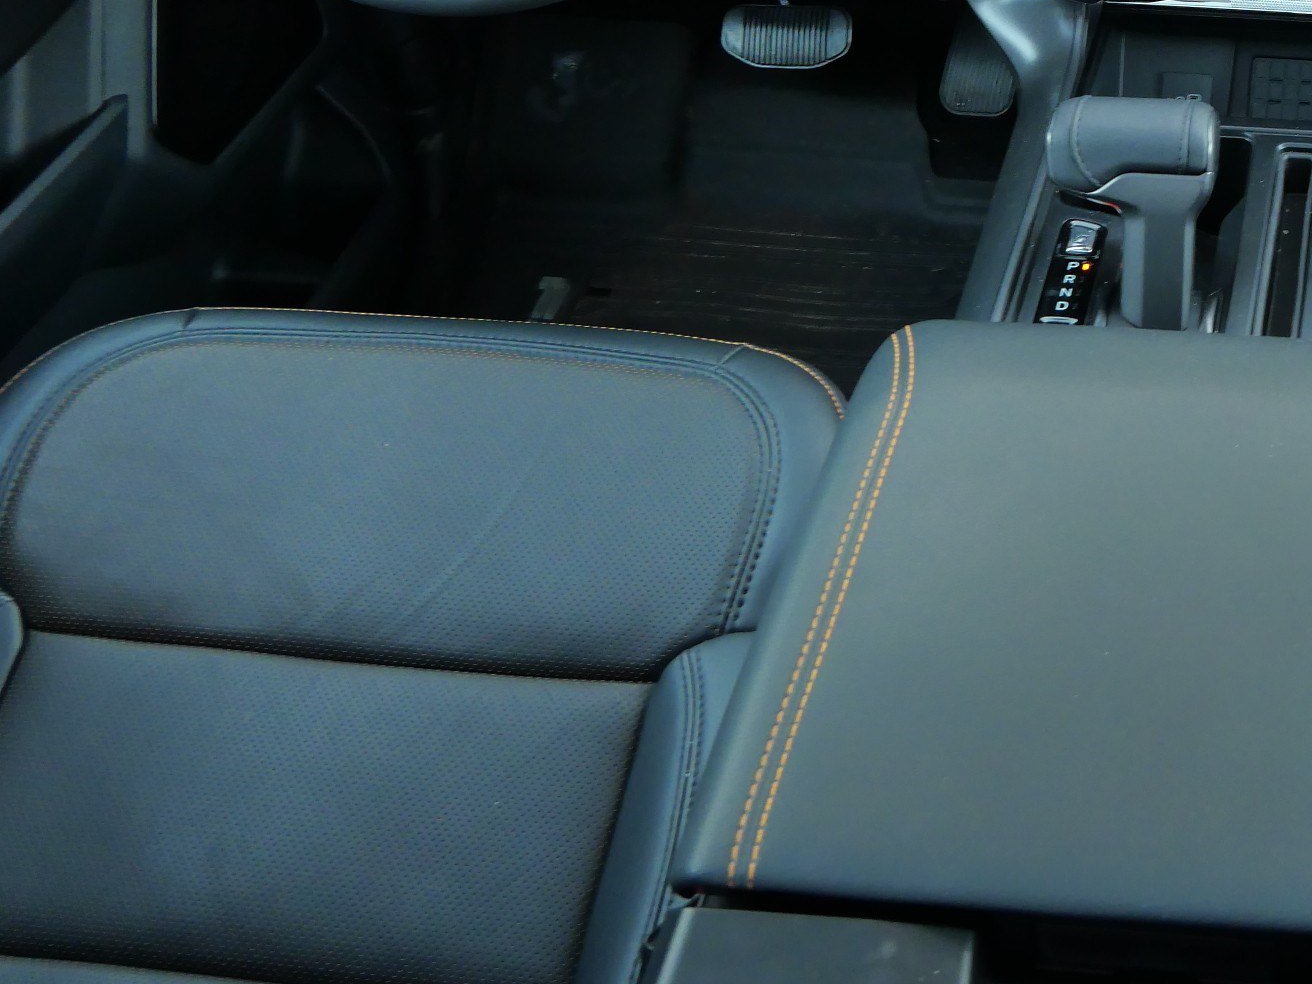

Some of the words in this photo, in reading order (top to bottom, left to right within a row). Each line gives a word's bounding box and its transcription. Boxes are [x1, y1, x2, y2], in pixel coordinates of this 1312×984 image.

[1066, 262, 1080, 271] P
[1062, 275, 1077, 284] R
[1059, 287, 1074, 297] N
[1055, 301, 1070, 311] D
